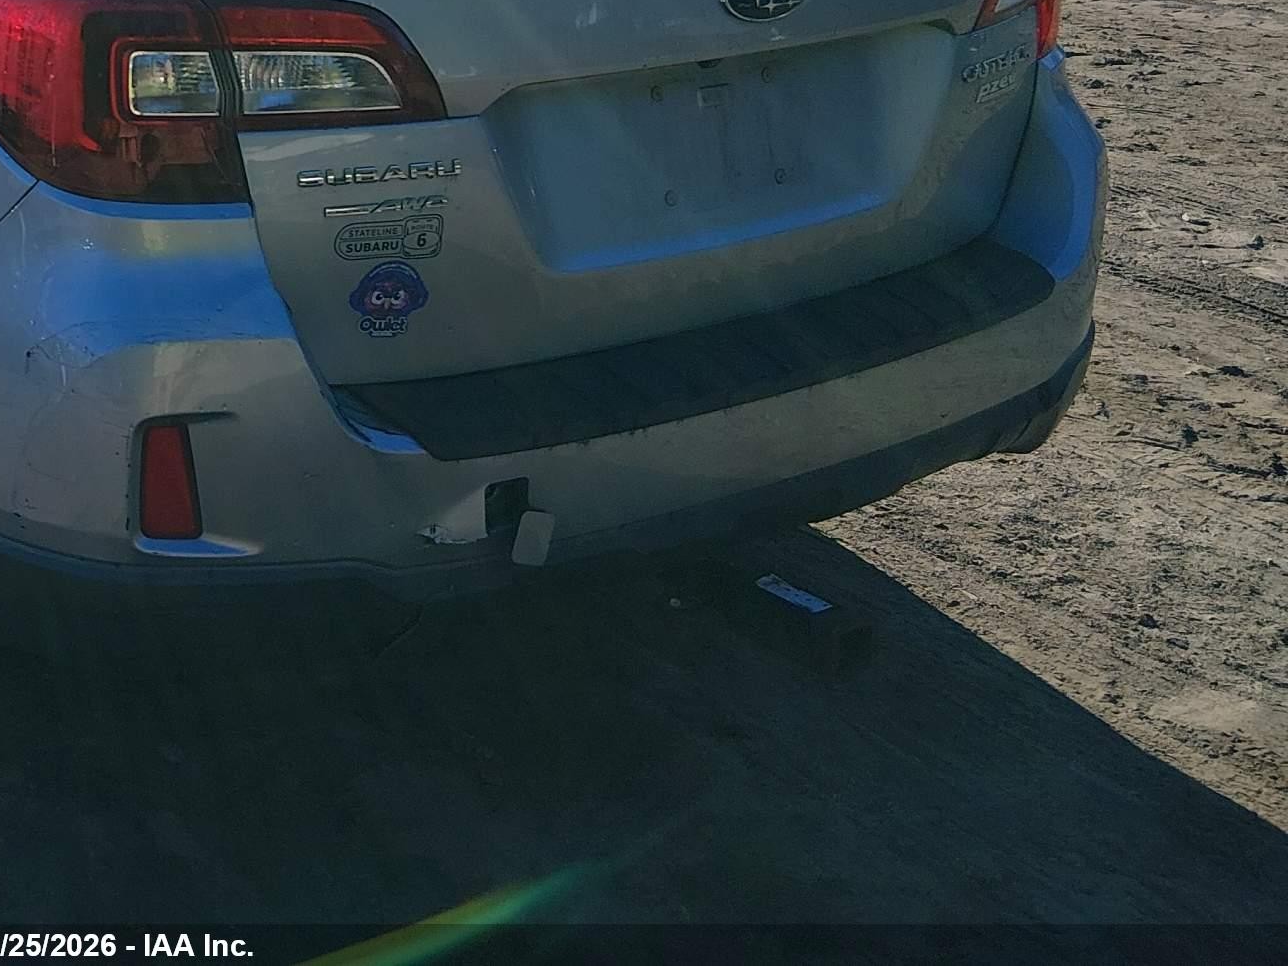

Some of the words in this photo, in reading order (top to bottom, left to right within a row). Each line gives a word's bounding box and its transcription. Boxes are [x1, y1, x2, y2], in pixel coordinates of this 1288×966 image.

[297, 158, 462, 188] SUBARU
[348, 227, 399, 238] STATELINE
[345, 241, 400, 253] SUBARU
[416, 233, 427, 248] 6
